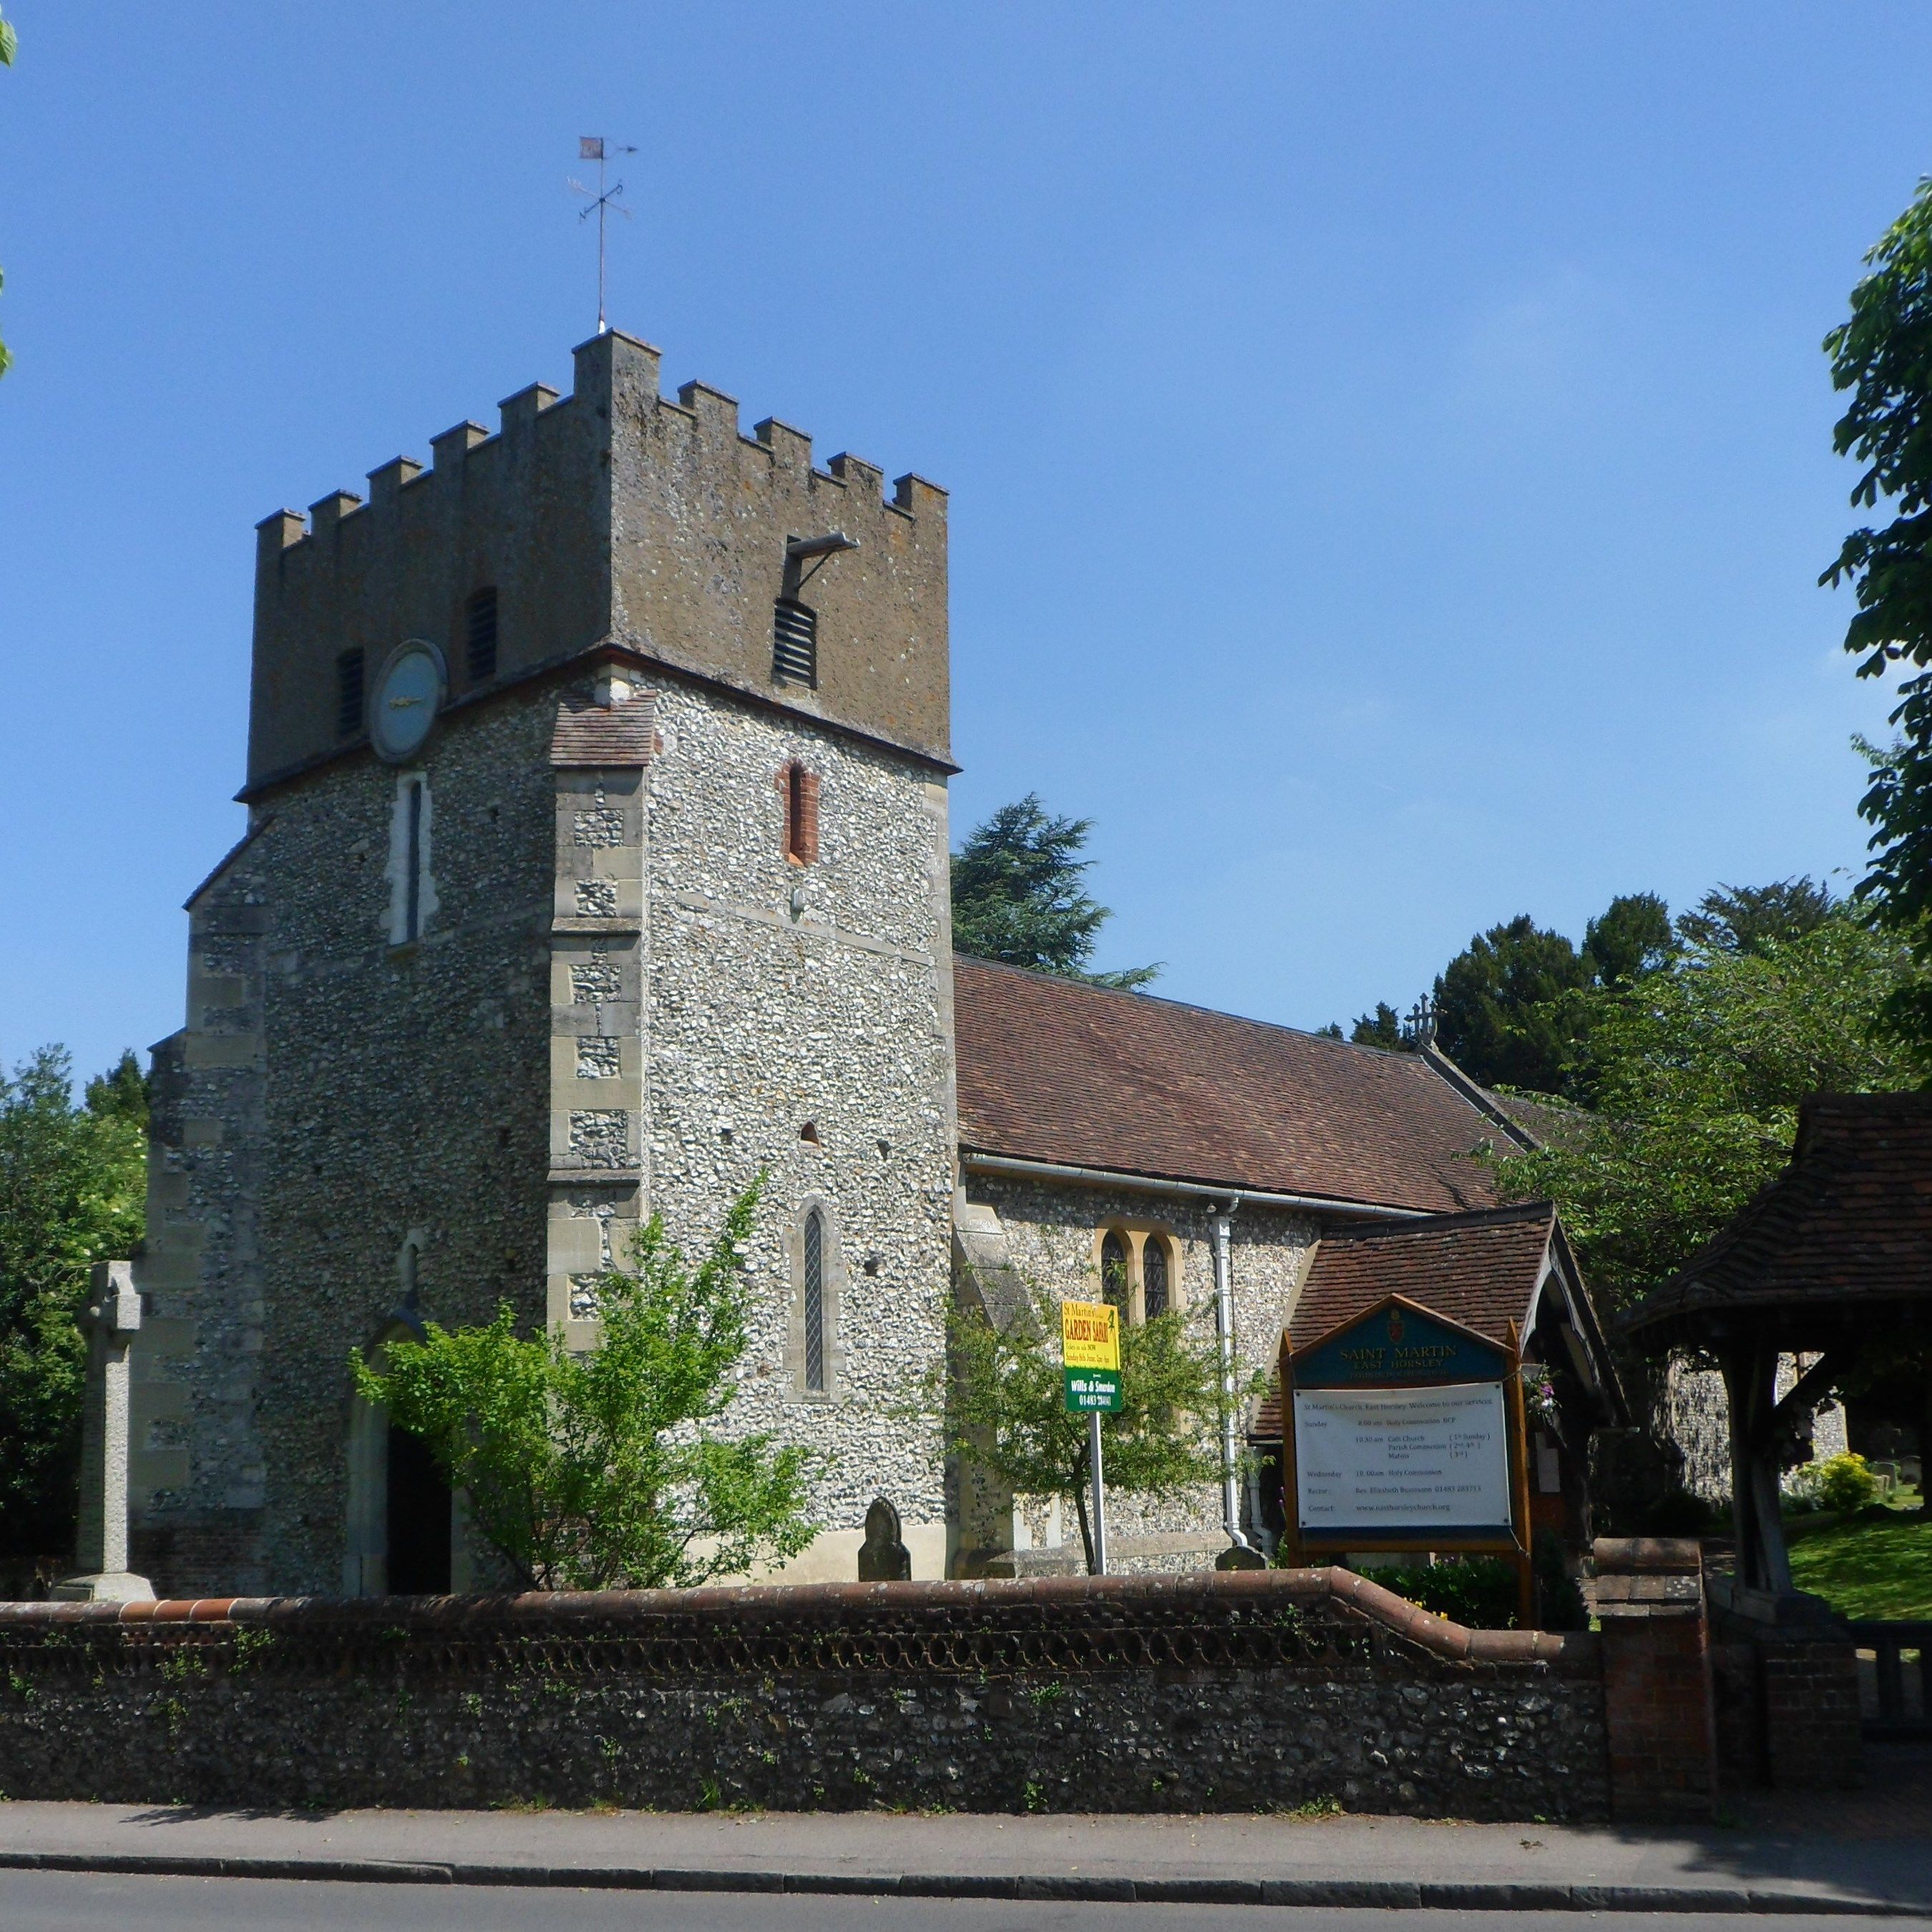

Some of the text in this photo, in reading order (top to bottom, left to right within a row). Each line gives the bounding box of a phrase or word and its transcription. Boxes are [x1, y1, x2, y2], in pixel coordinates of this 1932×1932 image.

[1064, 1302, 1095, 1318] St Martin's
[1065, 1318, 1108, 1343] GARDEN SAFARI
[1065, 1352, 1078, 1362] Sunday
[1340, 1345, 1457, 1360] SAINT MARTIN
[1354, 1359, 1443, 1370] EAST HORSLEY
[1070, 1380, 1087, 1392] Wills
[1088, 1380, 1094, 1392] &
[1079, 1395, 1096, 1406] 01483
[1356, 1503, 1450, 1512] www.easthorsleychurch.org
